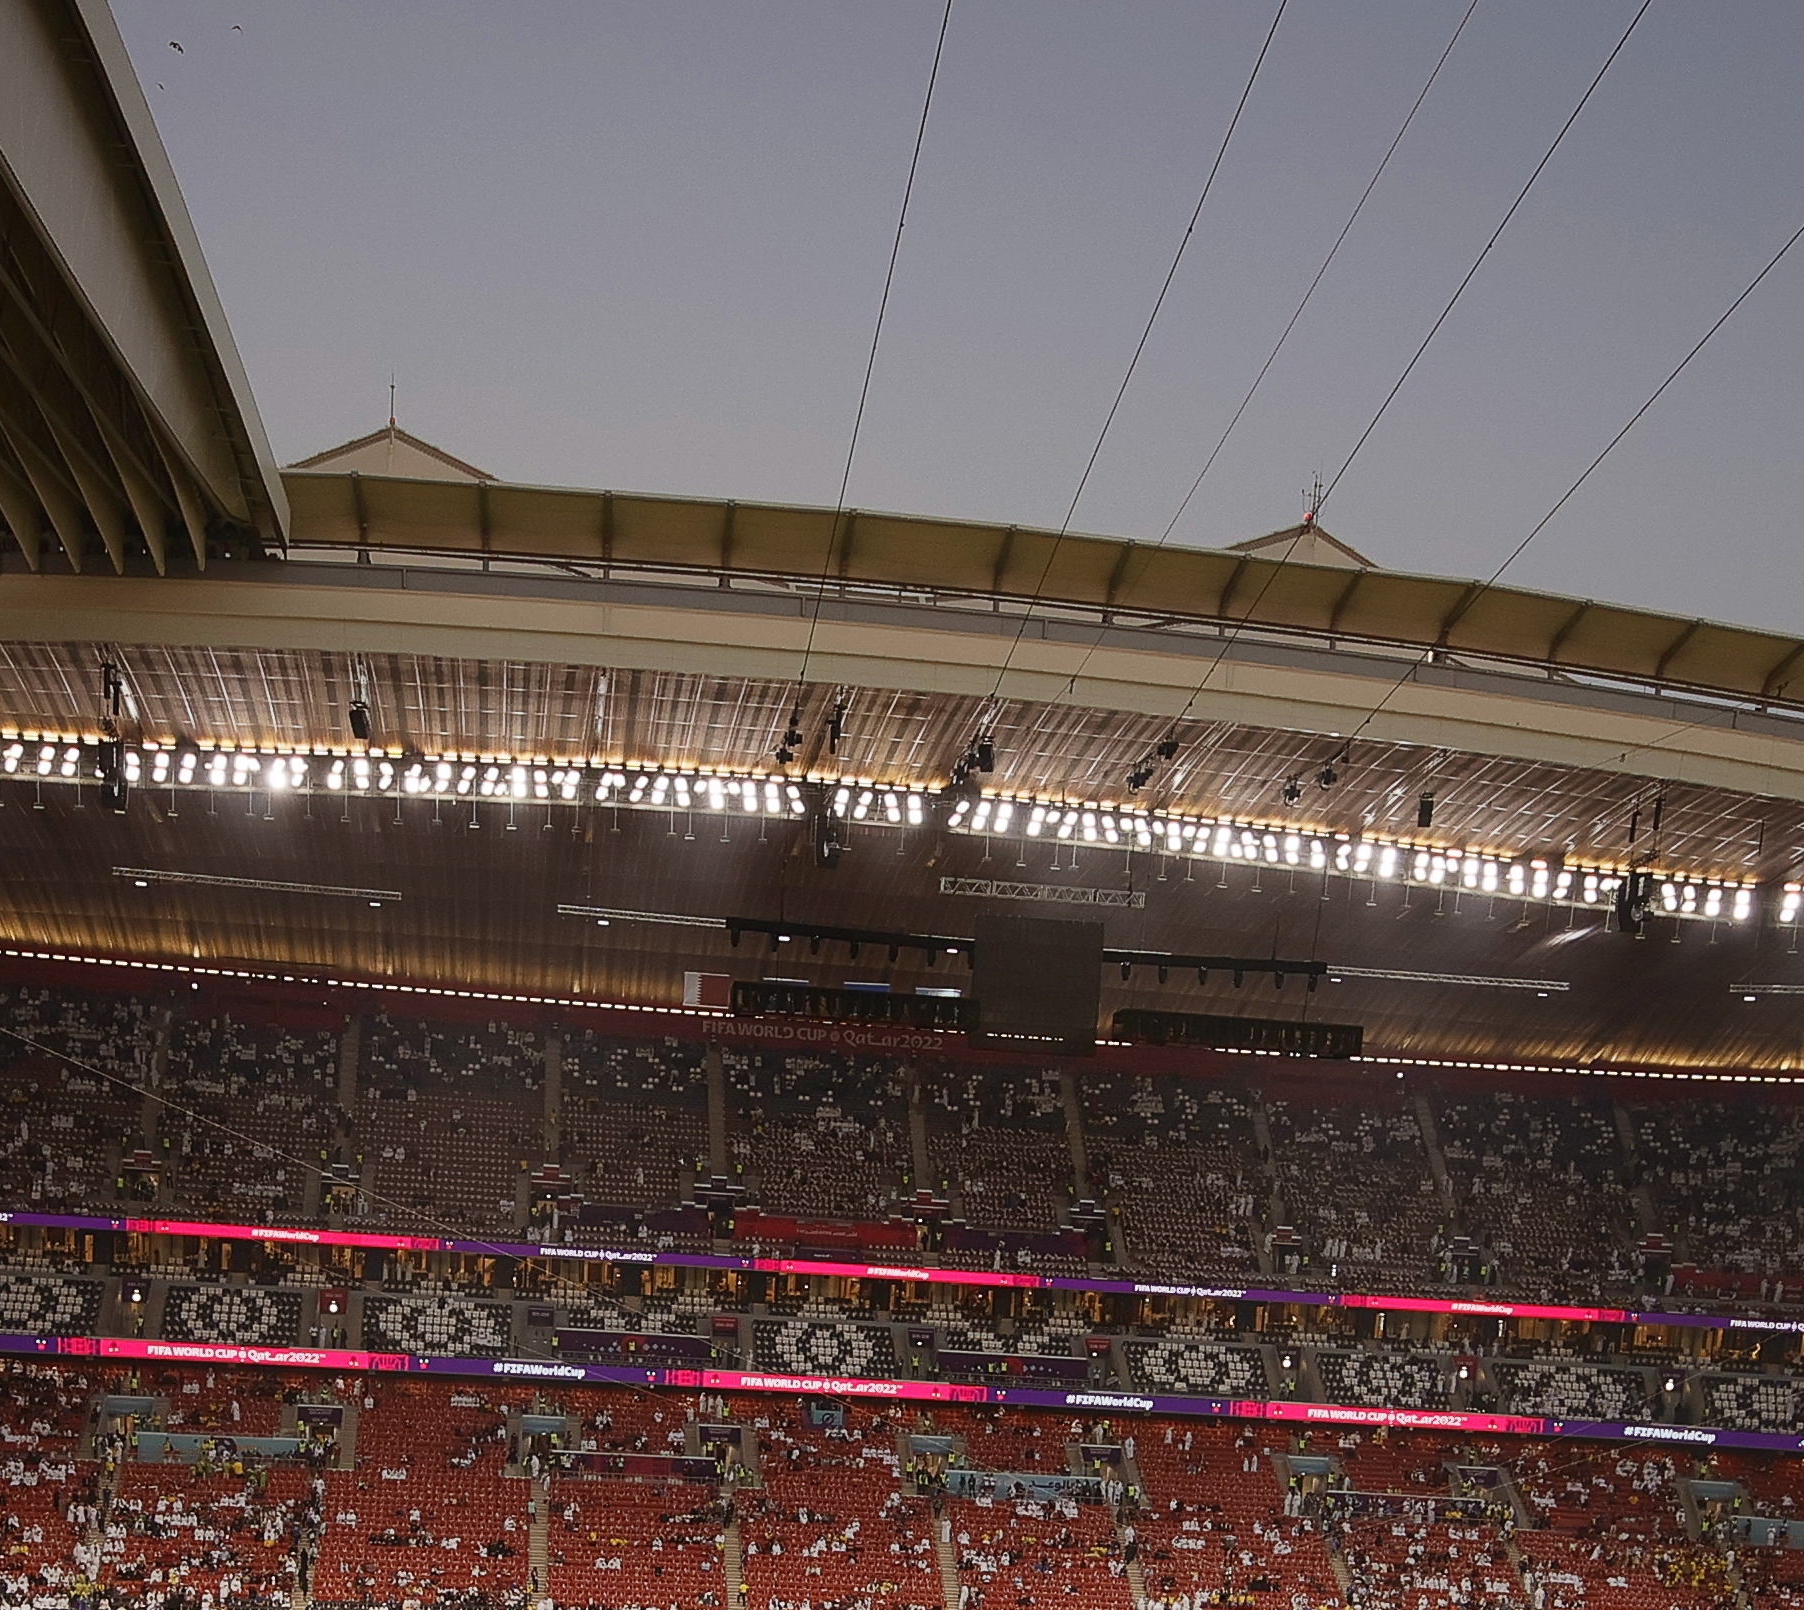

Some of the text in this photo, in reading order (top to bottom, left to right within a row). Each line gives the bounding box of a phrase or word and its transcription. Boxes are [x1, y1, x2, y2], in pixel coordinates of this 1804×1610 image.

[251, 1229, 319, 1242] #FIFAWorldCup
[147, 1346, 172, 1356] FIFA
[172, 1346, 214, 1358] WORLD
[215, 1348, 237, 1359] CUP
[493, 1362, 586, 1379] #FIFAWorldCup
[741, 1377, 763, 1387] FIFA
[763, 1377, 801, 1389] WORLD
[801, 1379, 822, 1390] CUP
[1065, 1394, 1154, 1410] #FIFAWorldCup
[1307, 1408, 1329, 1418] FIFA
[1329, 1409, 1366, 1420] WORLD
[1367, 1411, 1387, 1422] CUP
[1624, 1426, 1716, 1444] #FIFAWorldCup
